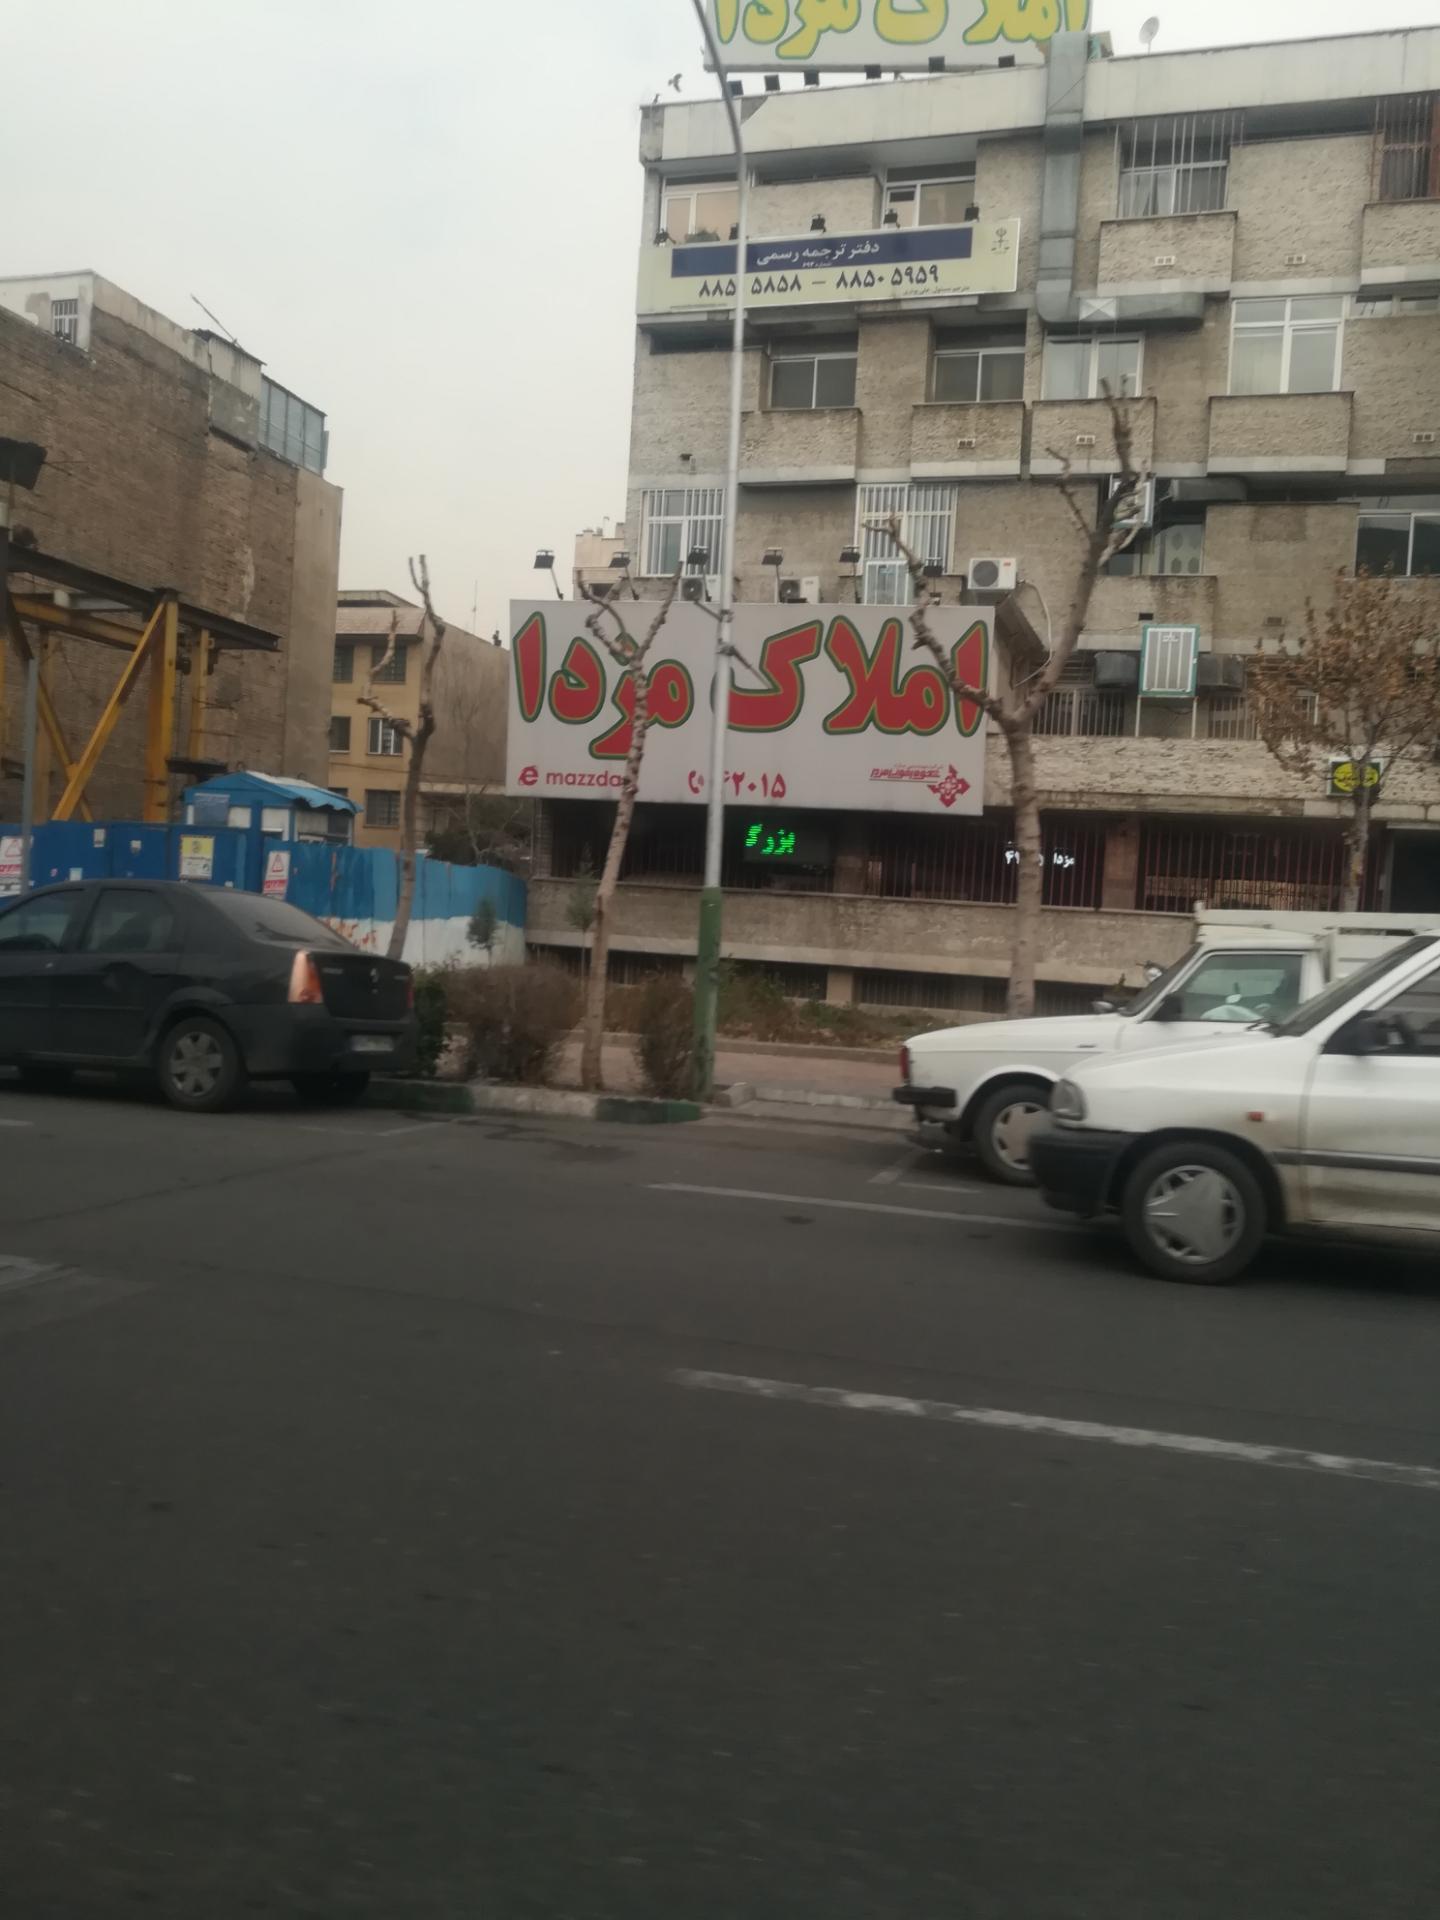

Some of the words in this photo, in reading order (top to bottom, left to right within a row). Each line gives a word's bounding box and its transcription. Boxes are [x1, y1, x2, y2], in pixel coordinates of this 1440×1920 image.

[756, 249, 800, 266] رسمی
[801, 243, 847, 260] ترجمه
[847, 240, 880, 259] دفتر
[513, 611, 694, 759] مزدا
[711, 615, 988, 737] املاک
[545, 770, 624, 787] mazzda
